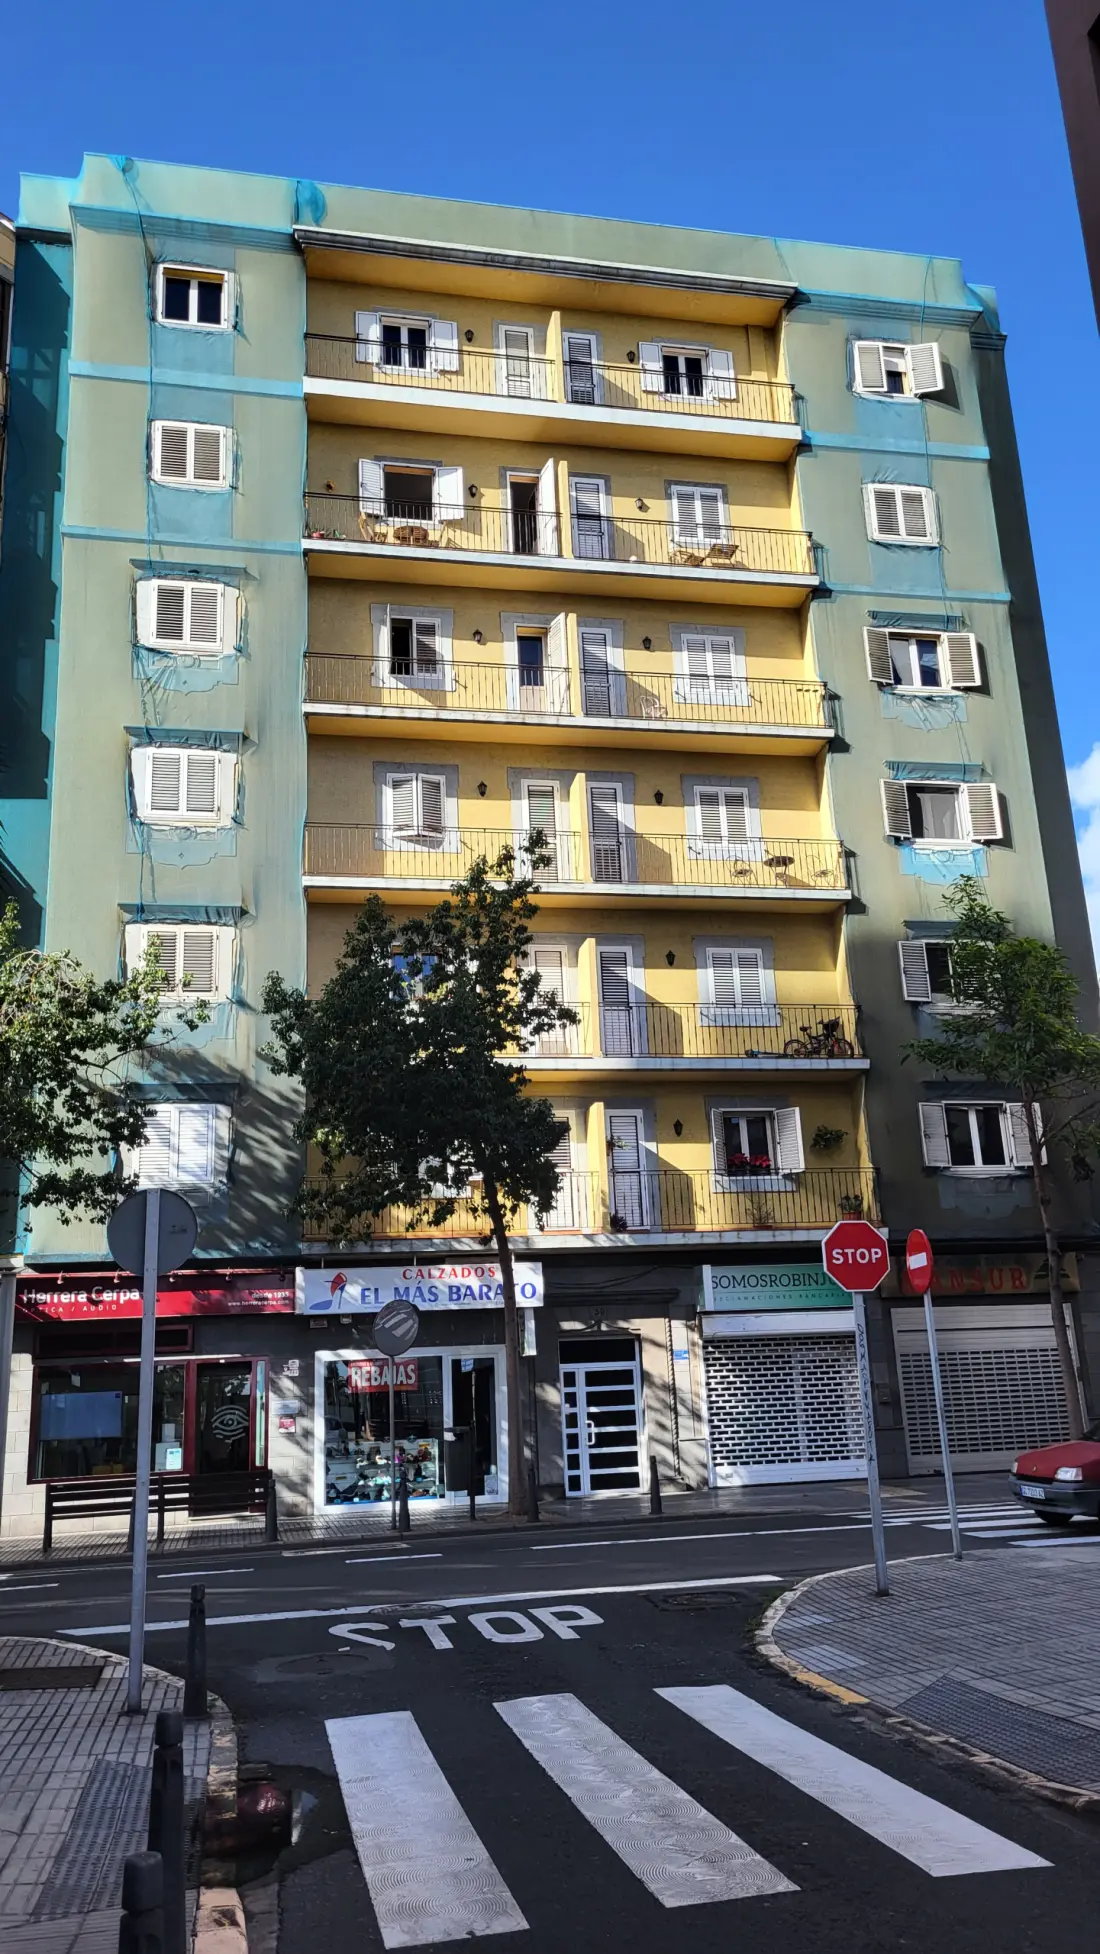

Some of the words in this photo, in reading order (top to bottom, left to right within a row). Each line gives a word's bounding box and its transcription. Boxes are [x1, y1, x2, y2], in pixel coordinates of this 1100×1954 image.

[832, 1247, 882, 1264] STOP
[402, 1266, 496, 1280] CALZADOS
[900, 1266, 1028, 1294] ANSUR
[23, 1288, 88, 1303] Herrera
[91, 1286, 140, 1304] Cerpa
[360, 1287, 385, 1305] EL
[393, 1281, 439, 1303] MÁS
[448, 1282, 537, 1302] BARAO
[82, 1304, 117, 1312] AUDIO
[328, 1604, 605, 1651] STOP
